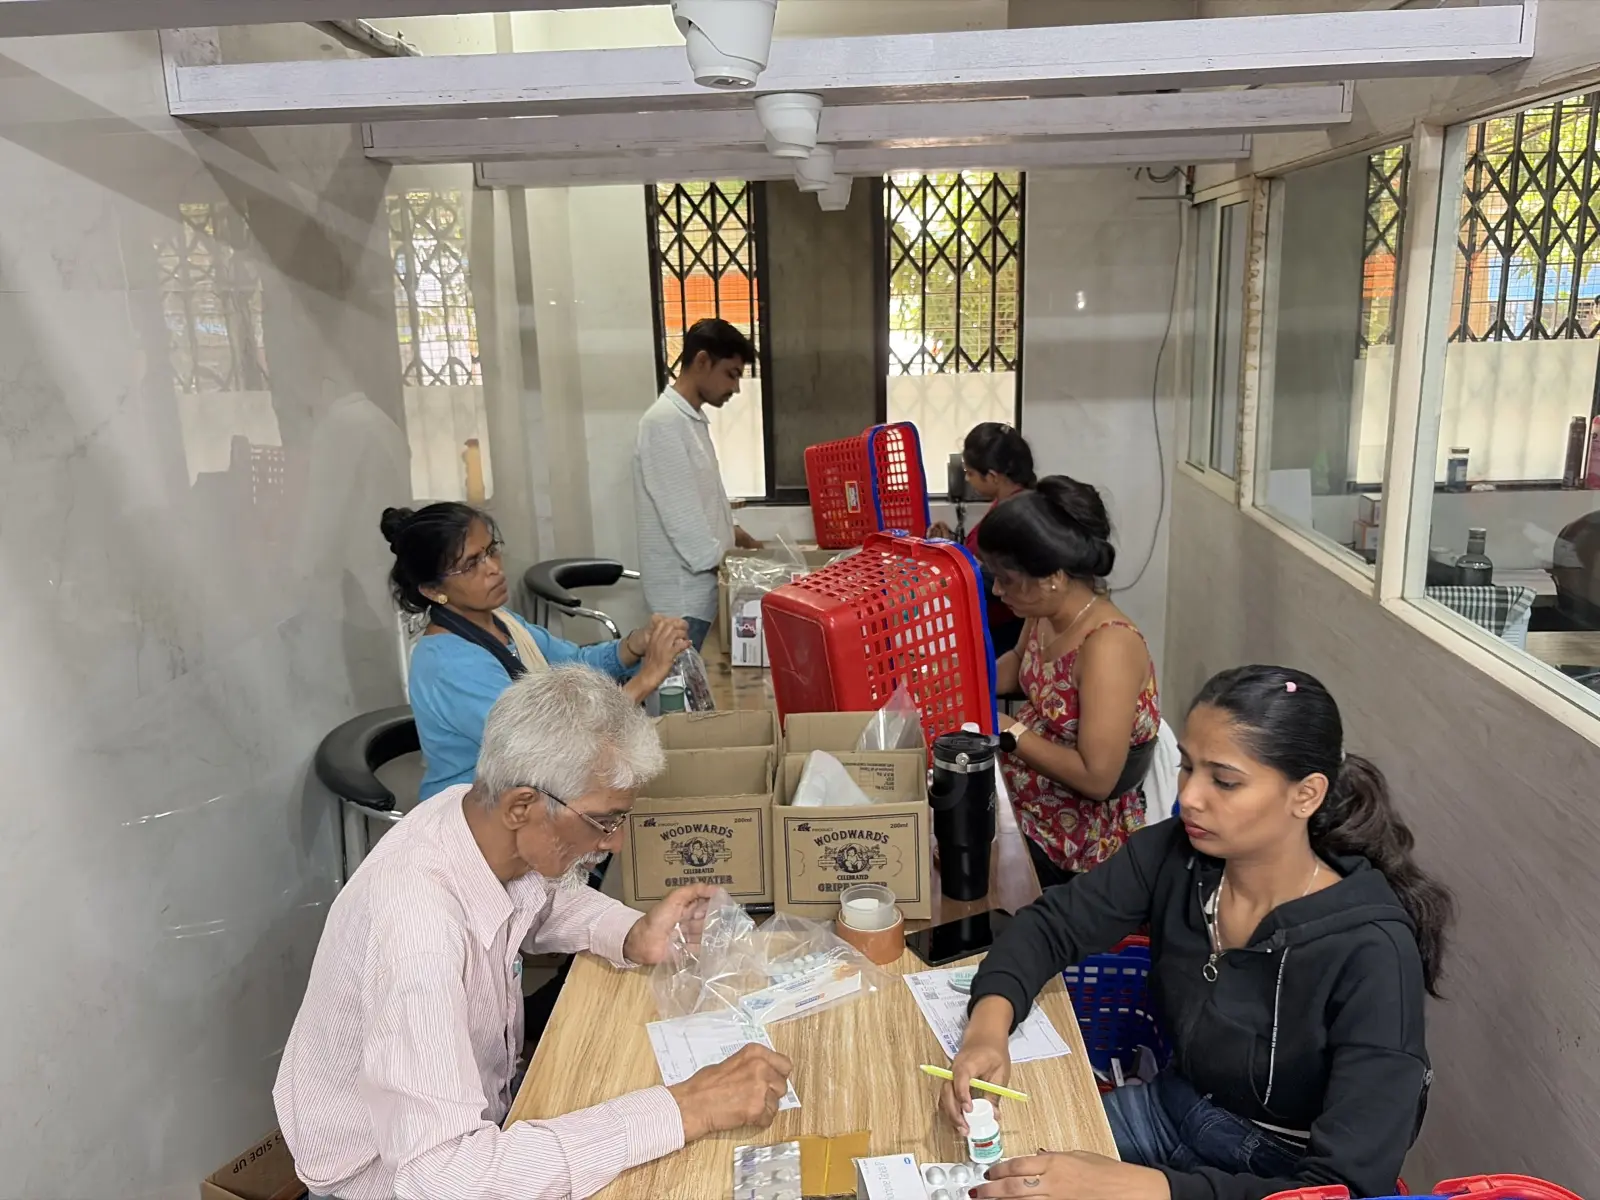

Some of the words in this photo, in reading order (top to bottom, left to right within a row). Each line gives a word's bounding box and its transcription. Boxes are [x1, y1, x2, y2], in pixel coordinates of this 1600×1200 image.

[660, 823, 734, 841] WOODWARD'S
[814, 829, 889, 847] WOODWARD'S
[665, 876, 697, 887] GRIPE
[696, 874, 734, 885] WATER
[249, 1139, 273, 1162] SIDE
[232, 1158, 247, 1174] UP
